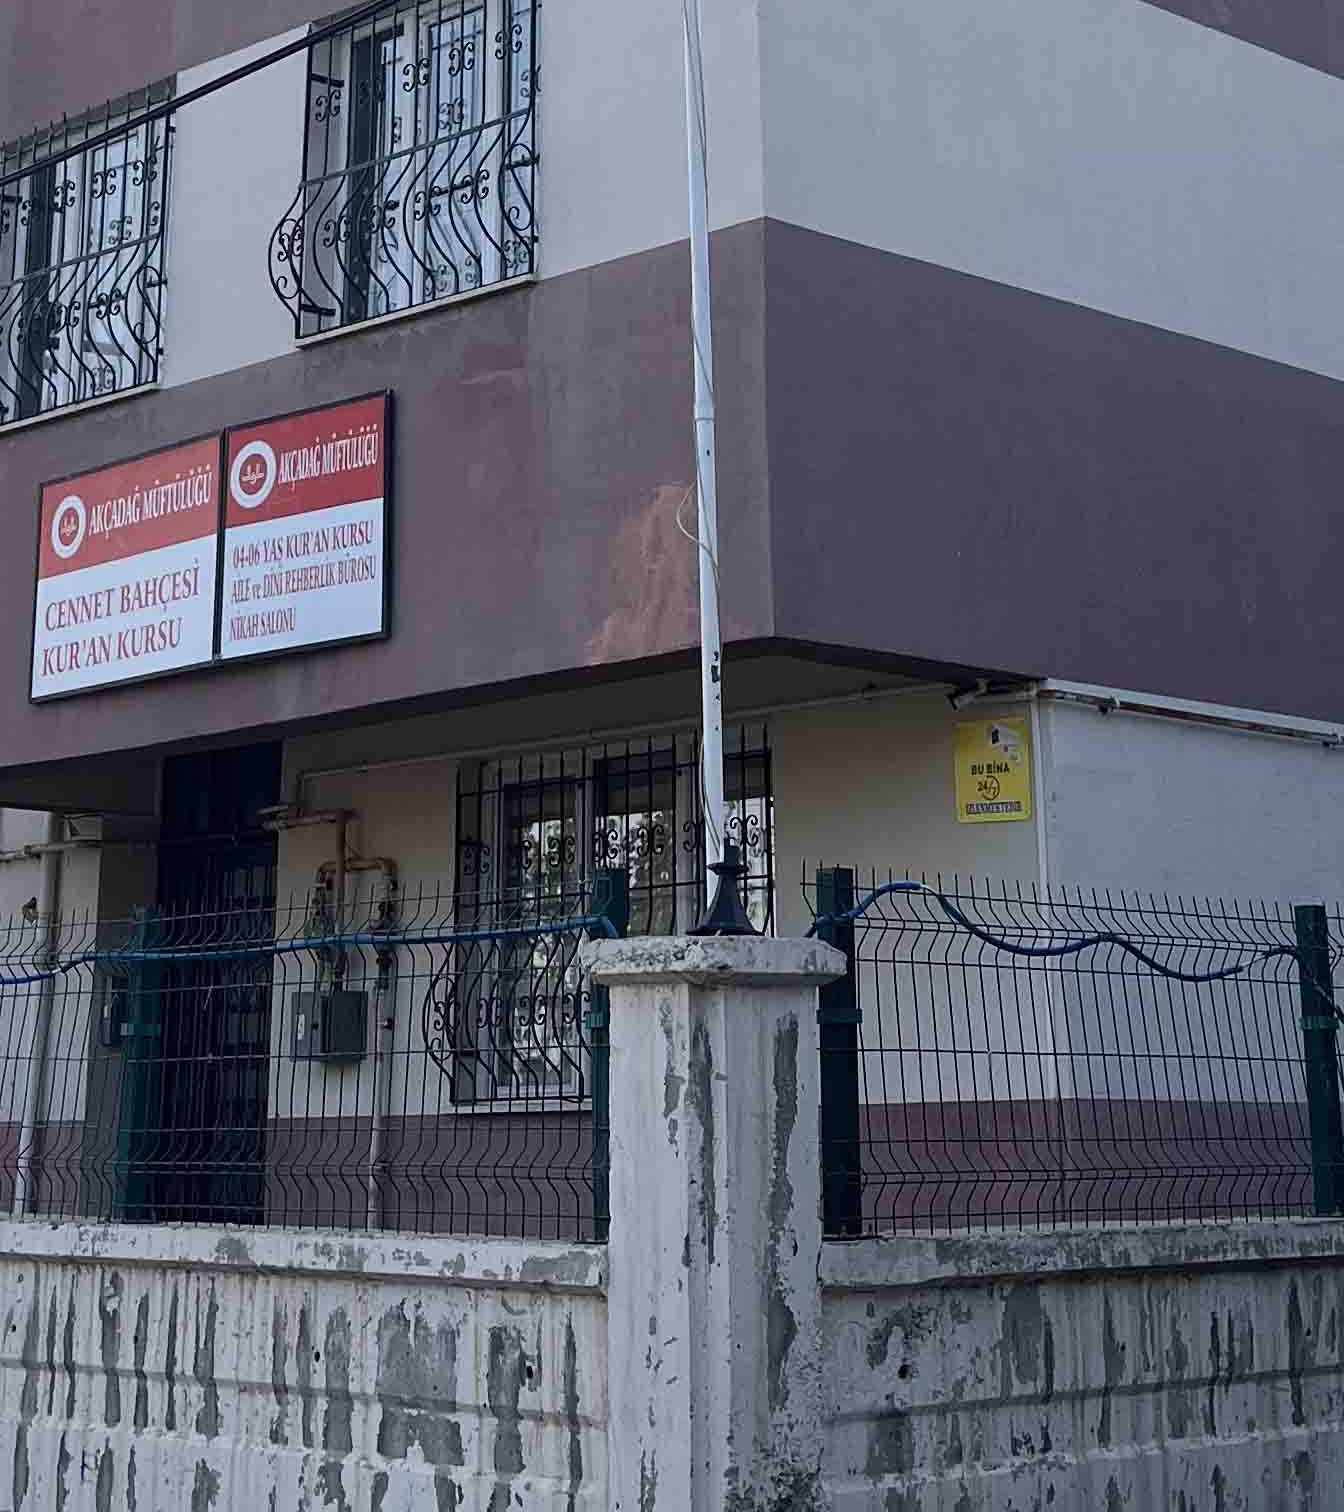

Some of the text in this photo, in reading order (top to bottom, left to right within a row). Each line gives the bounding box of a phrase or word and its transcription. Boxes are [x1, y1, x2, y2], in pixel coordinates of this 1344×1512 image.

[278, 423, 378, 491] AKÇADAĞ MÜFTÜLÜĞÜ
[89, 464, 212, 539] AKÇADAĞ MÜFTÜLÜĞÜ
[333, 520, 373, 550] KURSU
[45, 558, 200, 631] CENNET BAHÇESİ
[42, 617, 182, 676] KUR'AN KURSU
